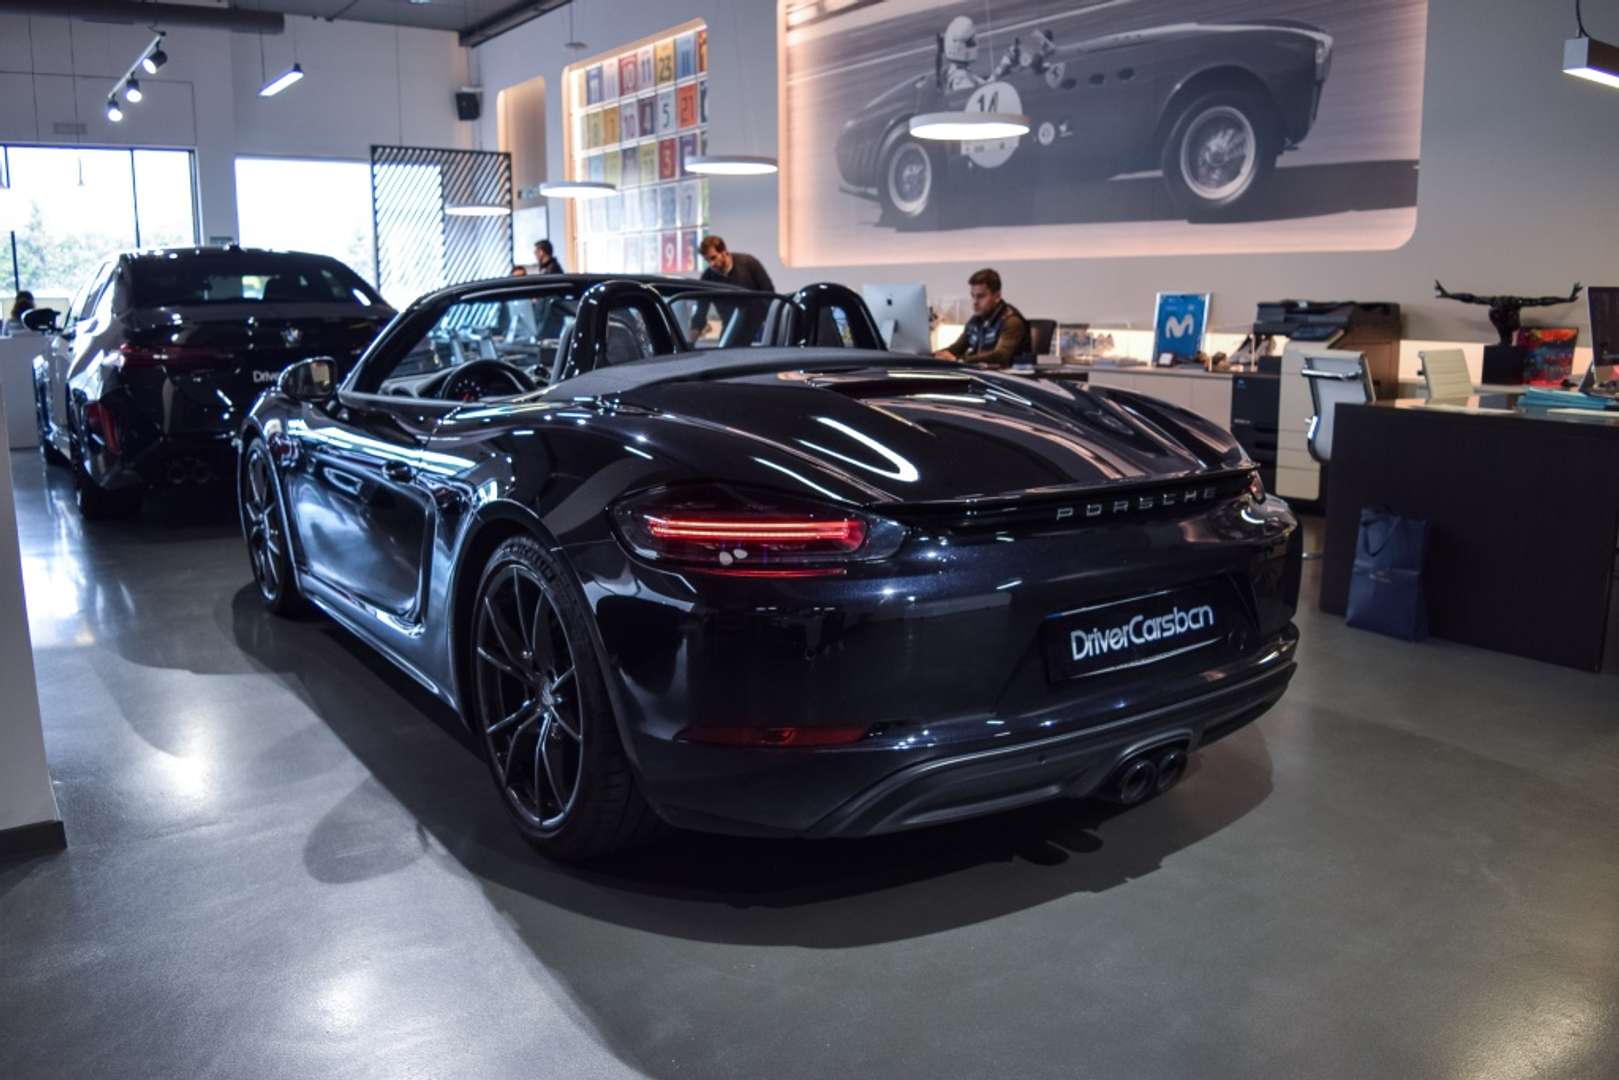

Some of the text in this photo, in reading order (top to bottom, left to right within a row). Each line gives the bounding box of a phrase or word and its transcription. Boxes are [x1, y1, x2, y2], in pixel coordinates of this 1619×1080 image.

[662, 102, 671, 129] 5
[1056, 487, 1216, 520] PORSCHE
[1070, 605, 1215, 661] DriverCarsbcn
